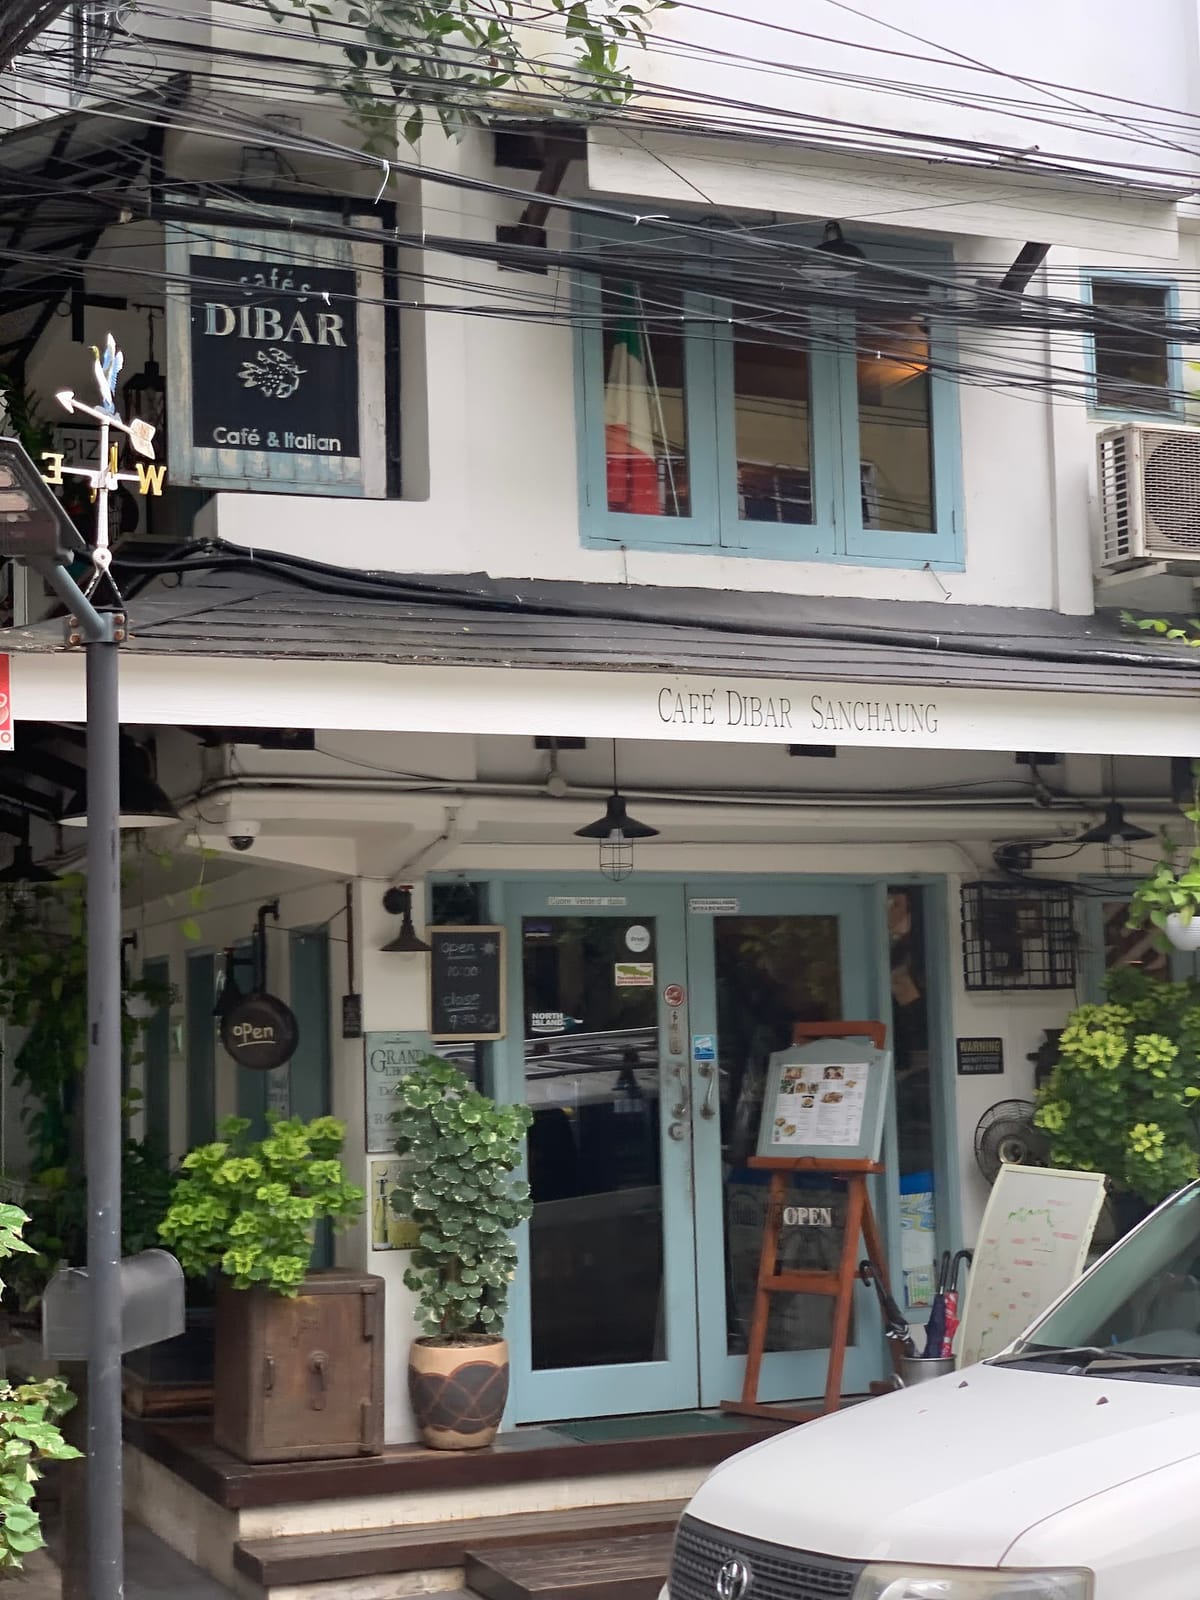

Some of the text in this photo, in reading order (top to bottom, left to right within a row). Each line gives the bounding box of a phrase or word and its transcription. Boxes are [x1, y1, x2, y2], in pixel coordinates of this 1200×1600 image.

[204, 302, 348, 347] DIBAR
[213, 427, 341, 452] Café & Italian
[135, 463, 167, 496] W
[726, 690, 792, 728] DIBAR
[811, 695, 938, 733] SANCHAUNG
[783, 1206, 833, 1227] OPEN
